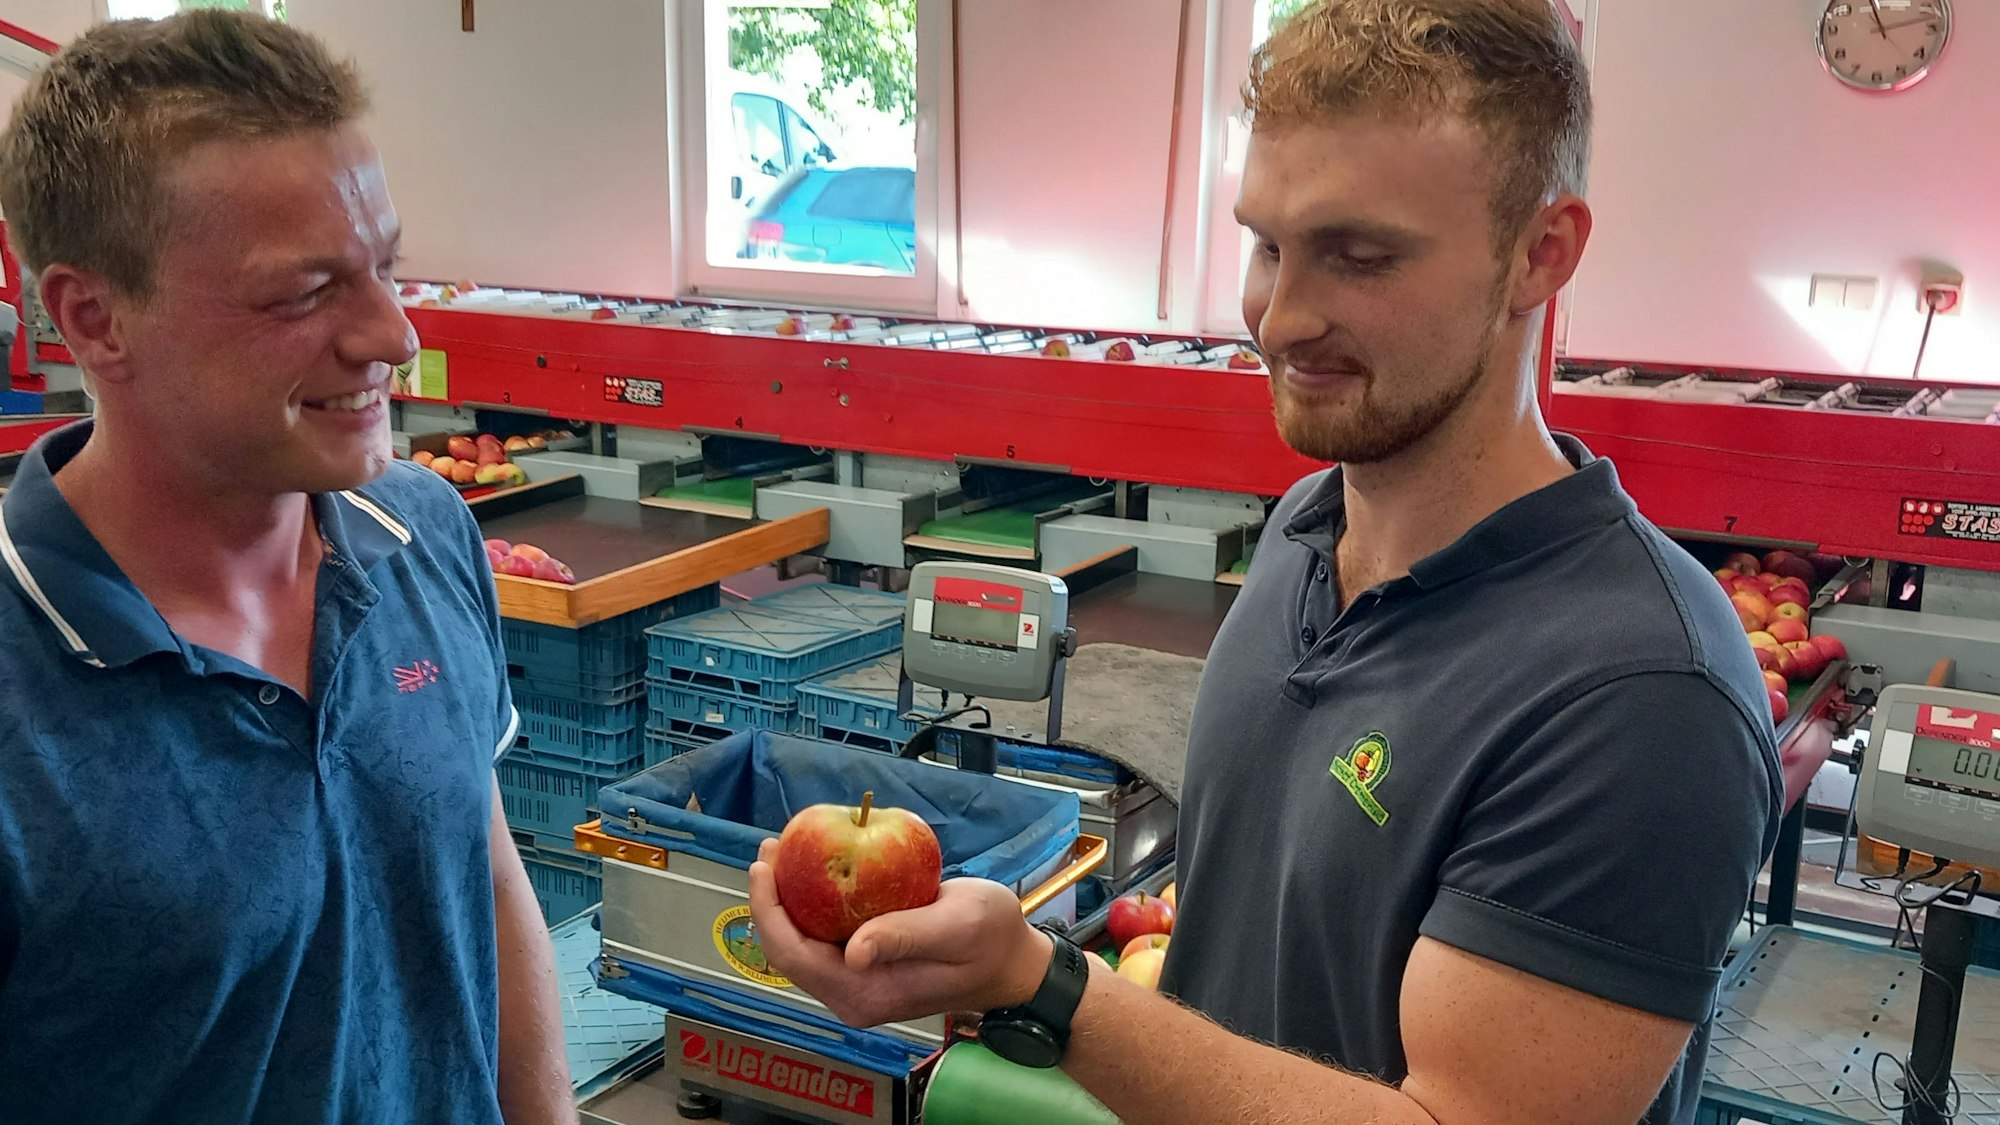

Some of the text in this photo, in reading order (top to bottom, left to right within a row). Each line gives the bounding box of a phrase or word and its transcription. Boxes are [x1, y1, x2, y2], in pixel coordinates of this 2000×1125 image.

[503, 391, 511, 404] 3
[735, 415, 743, 429] 4
[1006, 444, 1016, 460] 5
[1723, 515, 1738, 534] 7
[1942, 513, 2000, 535] STAS
[719, 1040, 866, 1108] Defender
